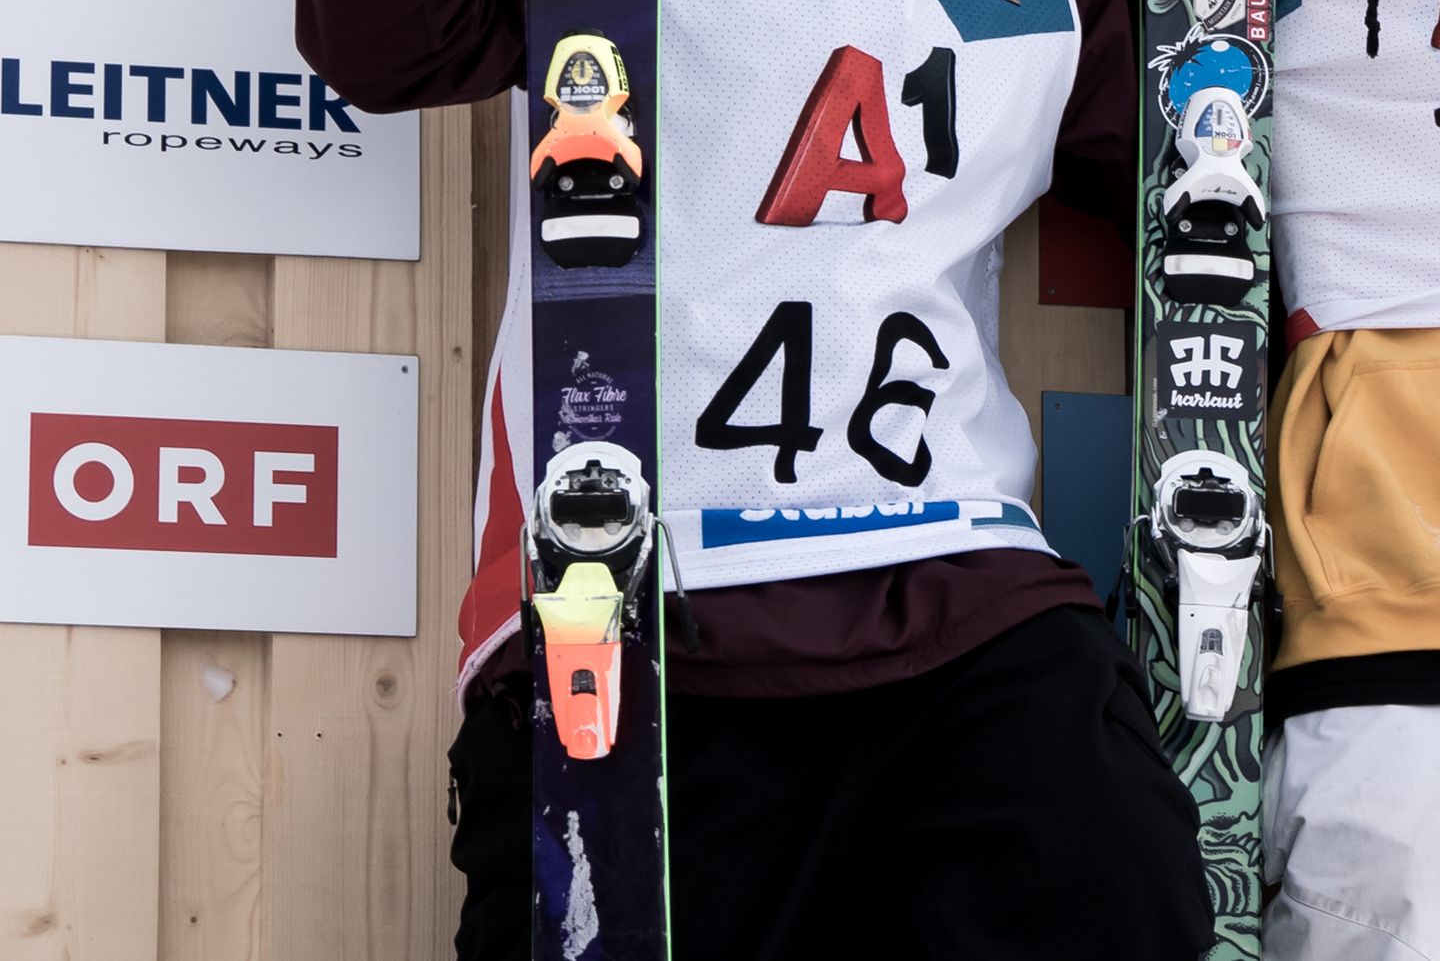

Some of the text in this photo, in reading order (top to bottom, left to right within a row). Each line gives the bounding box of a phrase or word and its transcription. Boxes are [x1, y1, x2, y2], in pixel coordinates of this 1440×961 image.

[1, 58, 361, 133] LEITNER
[103, 131, 363, 160] ropeways
[754, 44, 960, 227] A1
[593, 384, 628, 403] Fibre
[695, 300, 950, 488] 46
[1170, 389, 1243, 409] harlaut
[53, 442, 316, 527] ORF
